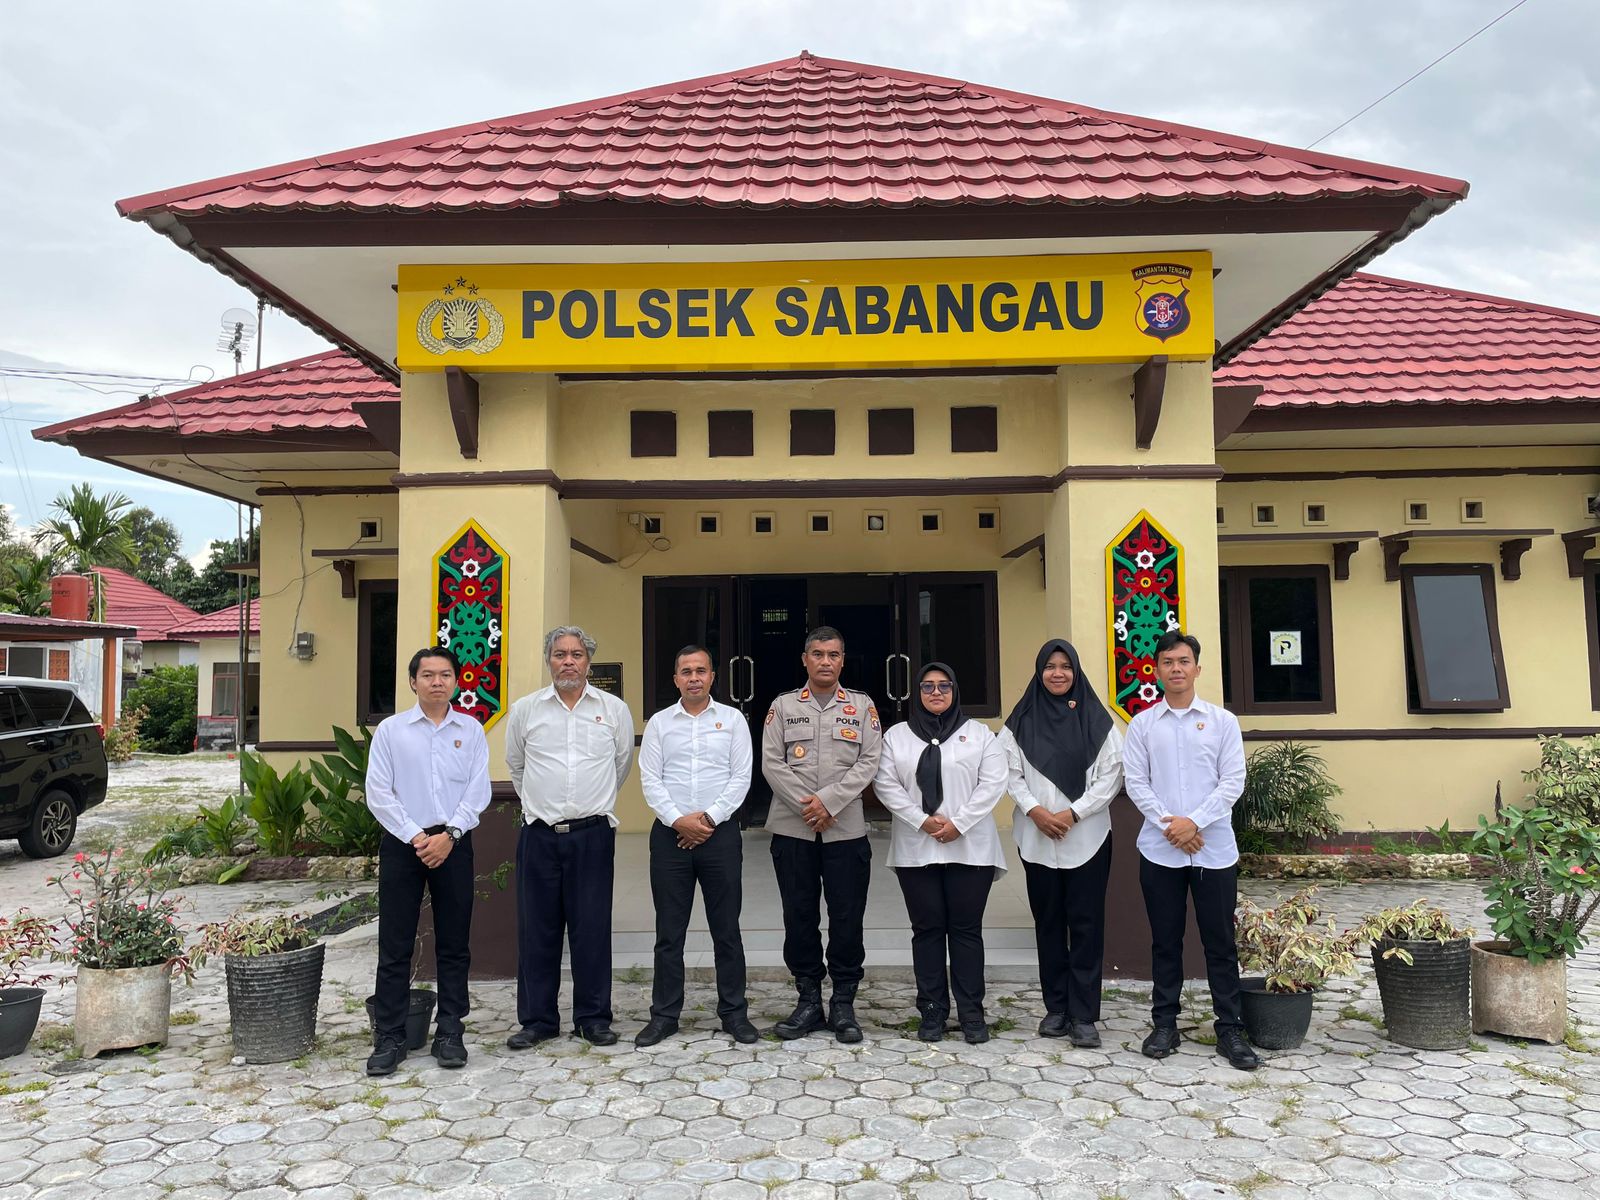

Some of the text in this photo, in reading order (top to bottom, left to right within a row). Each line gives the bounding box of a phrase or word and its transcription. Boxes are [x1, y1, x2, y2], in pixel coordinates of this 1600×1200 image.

[1134, 266, 1190, 277] KALIMANTAN TENGAH
[522, 281, 1104, 339] POLSEK SABANGAU
[786, 717, 810, 726] TAUFIQ
[836, 717, 860, 727] POLRI
